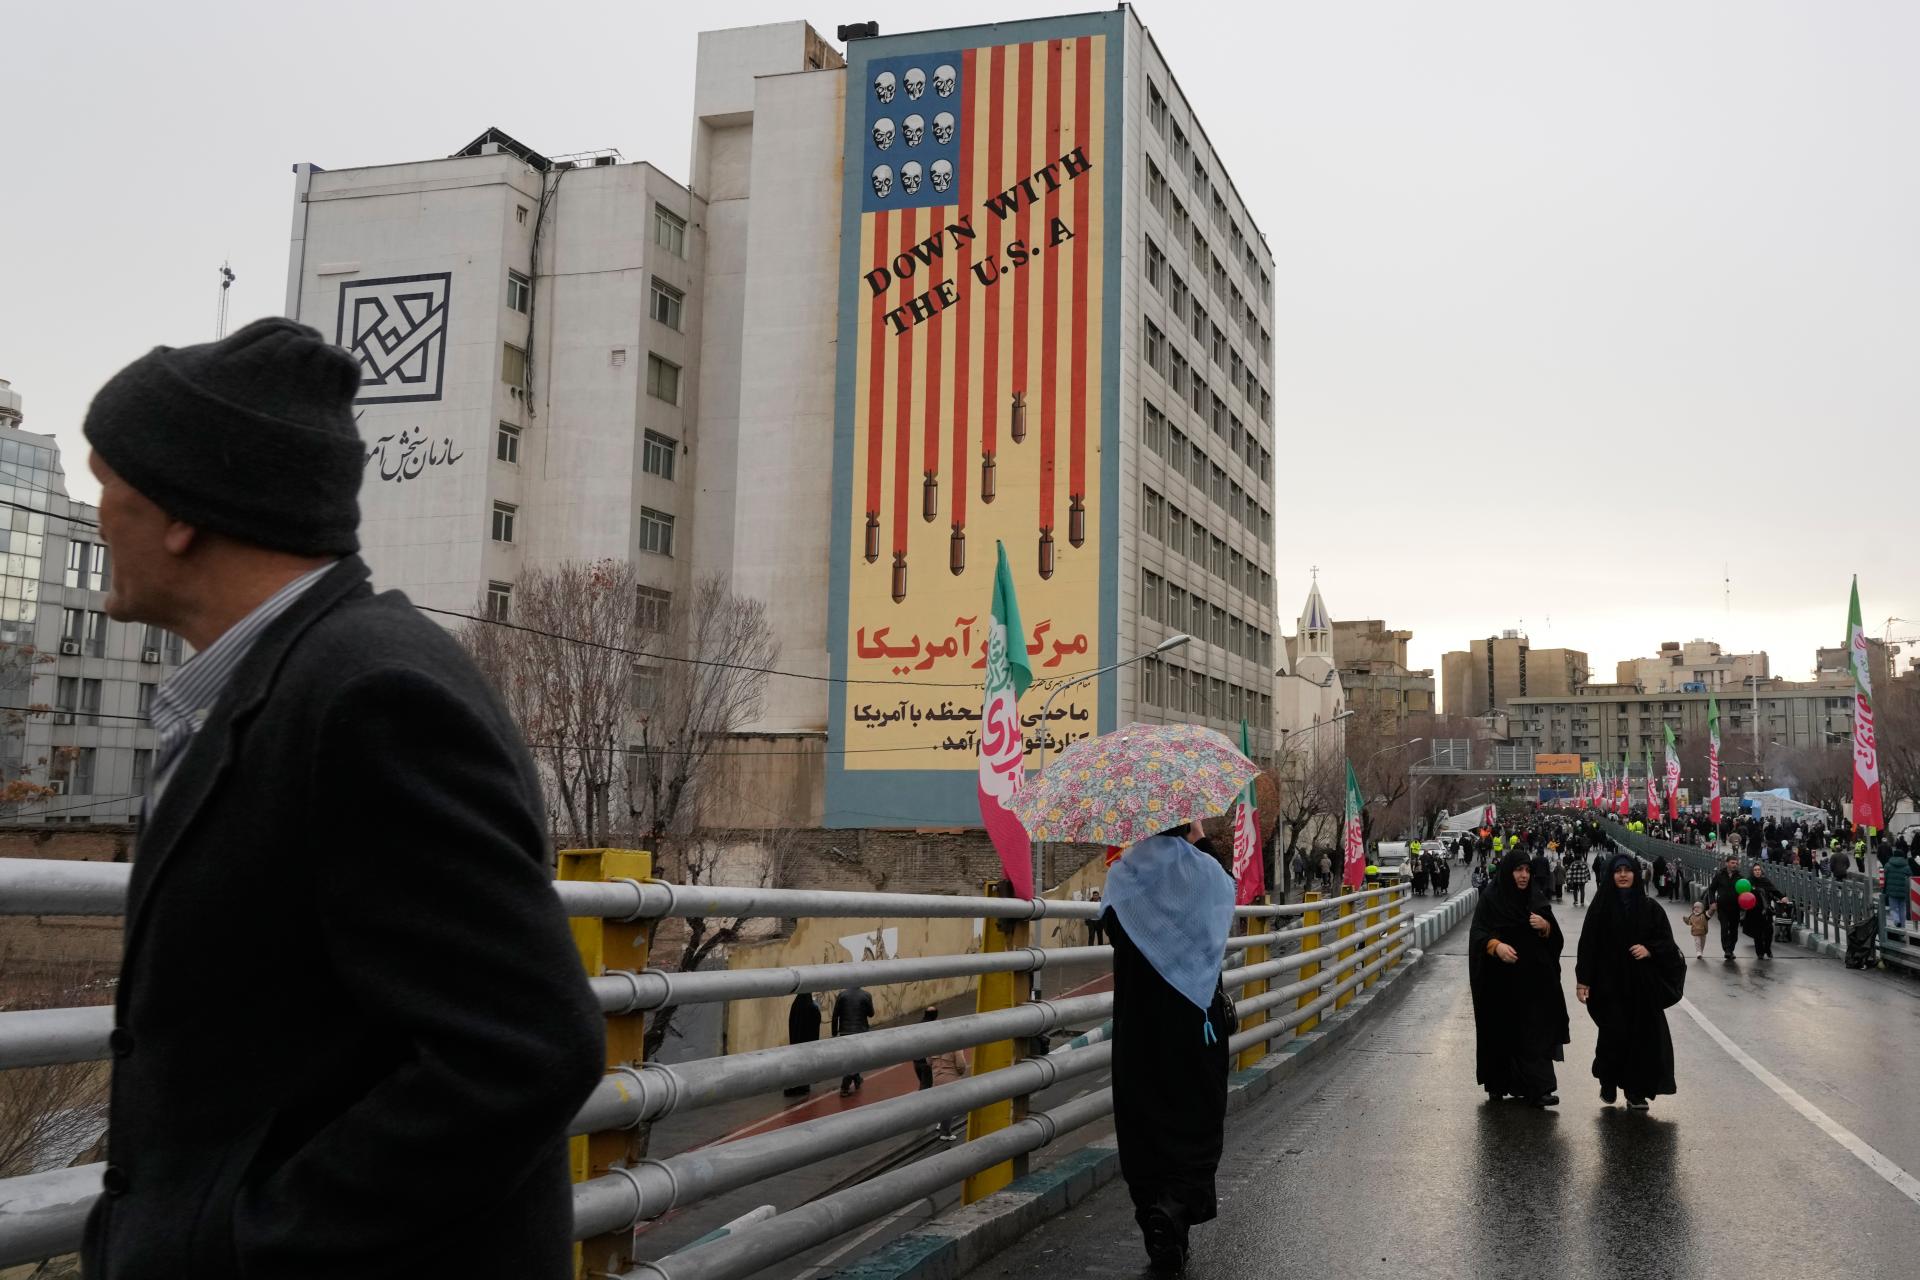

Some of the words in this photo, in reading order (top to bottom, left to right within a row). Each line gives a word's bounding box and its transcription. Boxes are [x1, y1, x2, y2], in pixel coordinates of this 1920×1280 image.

[864, 215, 976, 298] DOWN
[983, 146, 1093, 221] WITH
[882, 278, 961, 336] THE
[381, 426, 428, 483] سنجش
[403, 437, 464, 479] سازمان
[857, 616, 978, 676] آمریکا
[854, 700, 909, 728] آمریکا
[910, 703, 922, 728] با
[1070, 702, 1089, 721] ما
